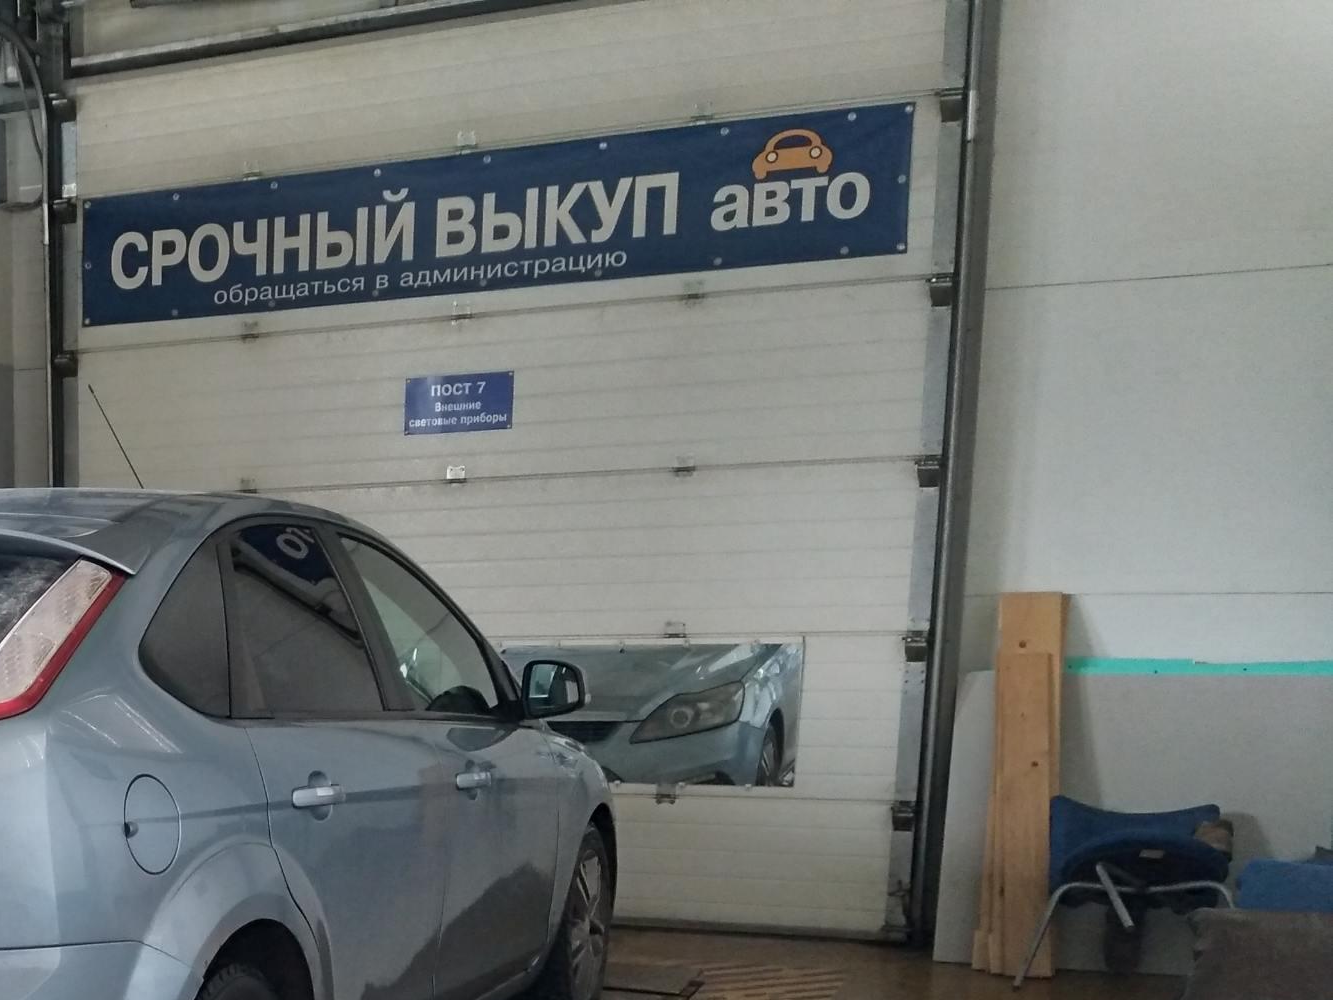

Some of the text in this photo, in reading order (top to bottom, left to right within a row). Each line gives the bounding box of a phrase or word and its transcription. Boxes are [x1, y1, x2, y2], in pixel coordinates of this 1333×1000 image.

[110, 170, 872, 290] СРОЧНЫЙ ВЫКУП авто
[213, 249, 627, 306] обращаться в администрацию
[430, 381, 486, 397] ПОСТ 7
[434, 401, 482, 412] Внешние
[408, 412, 507, 428] световые приборы
